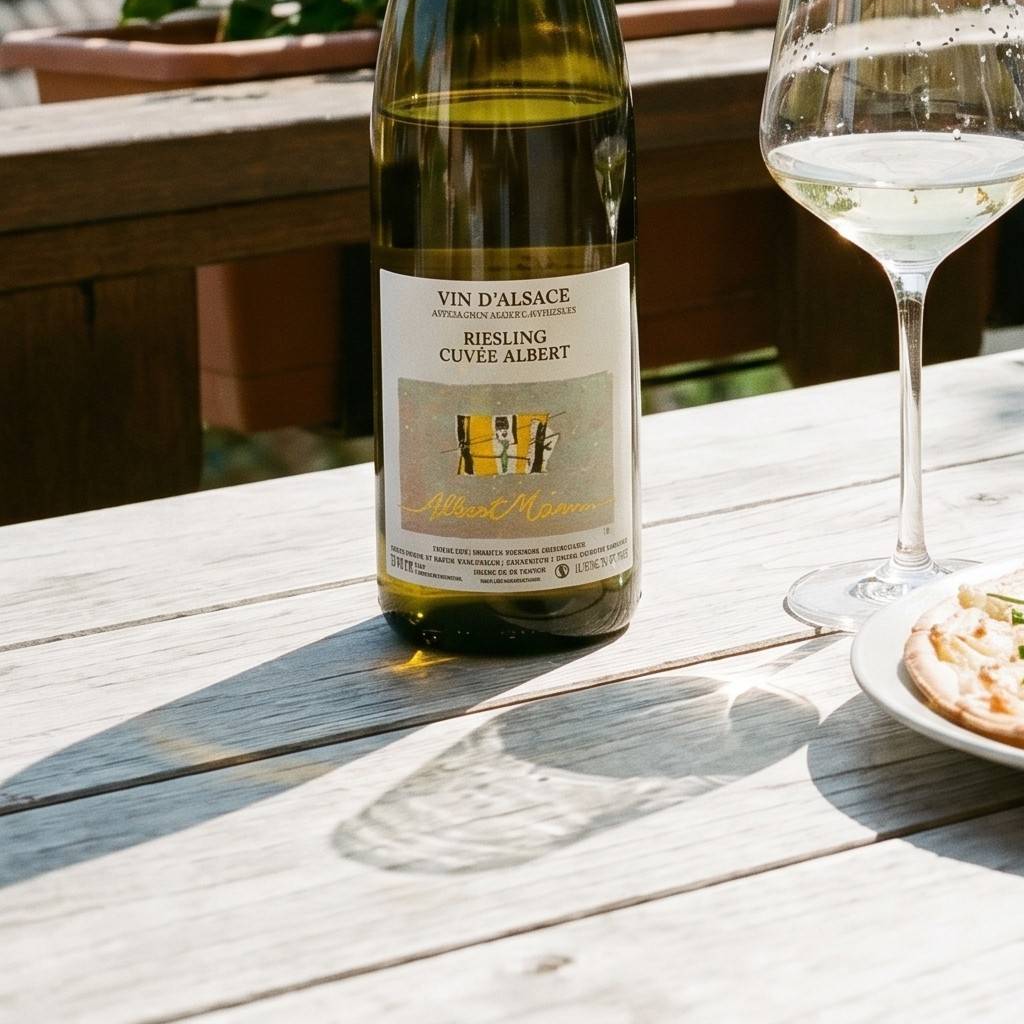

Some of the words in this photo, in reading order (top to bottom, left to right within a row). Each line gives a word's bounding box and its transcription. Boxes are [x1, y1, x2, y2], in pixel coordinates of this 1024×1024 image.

[438, 290, 472, 307] VIN
[478, 287, 571, 307] D'ALSACE
[463, 329, 547, 346] RIESLING
[503, 344, 571, 364] ALBERT
